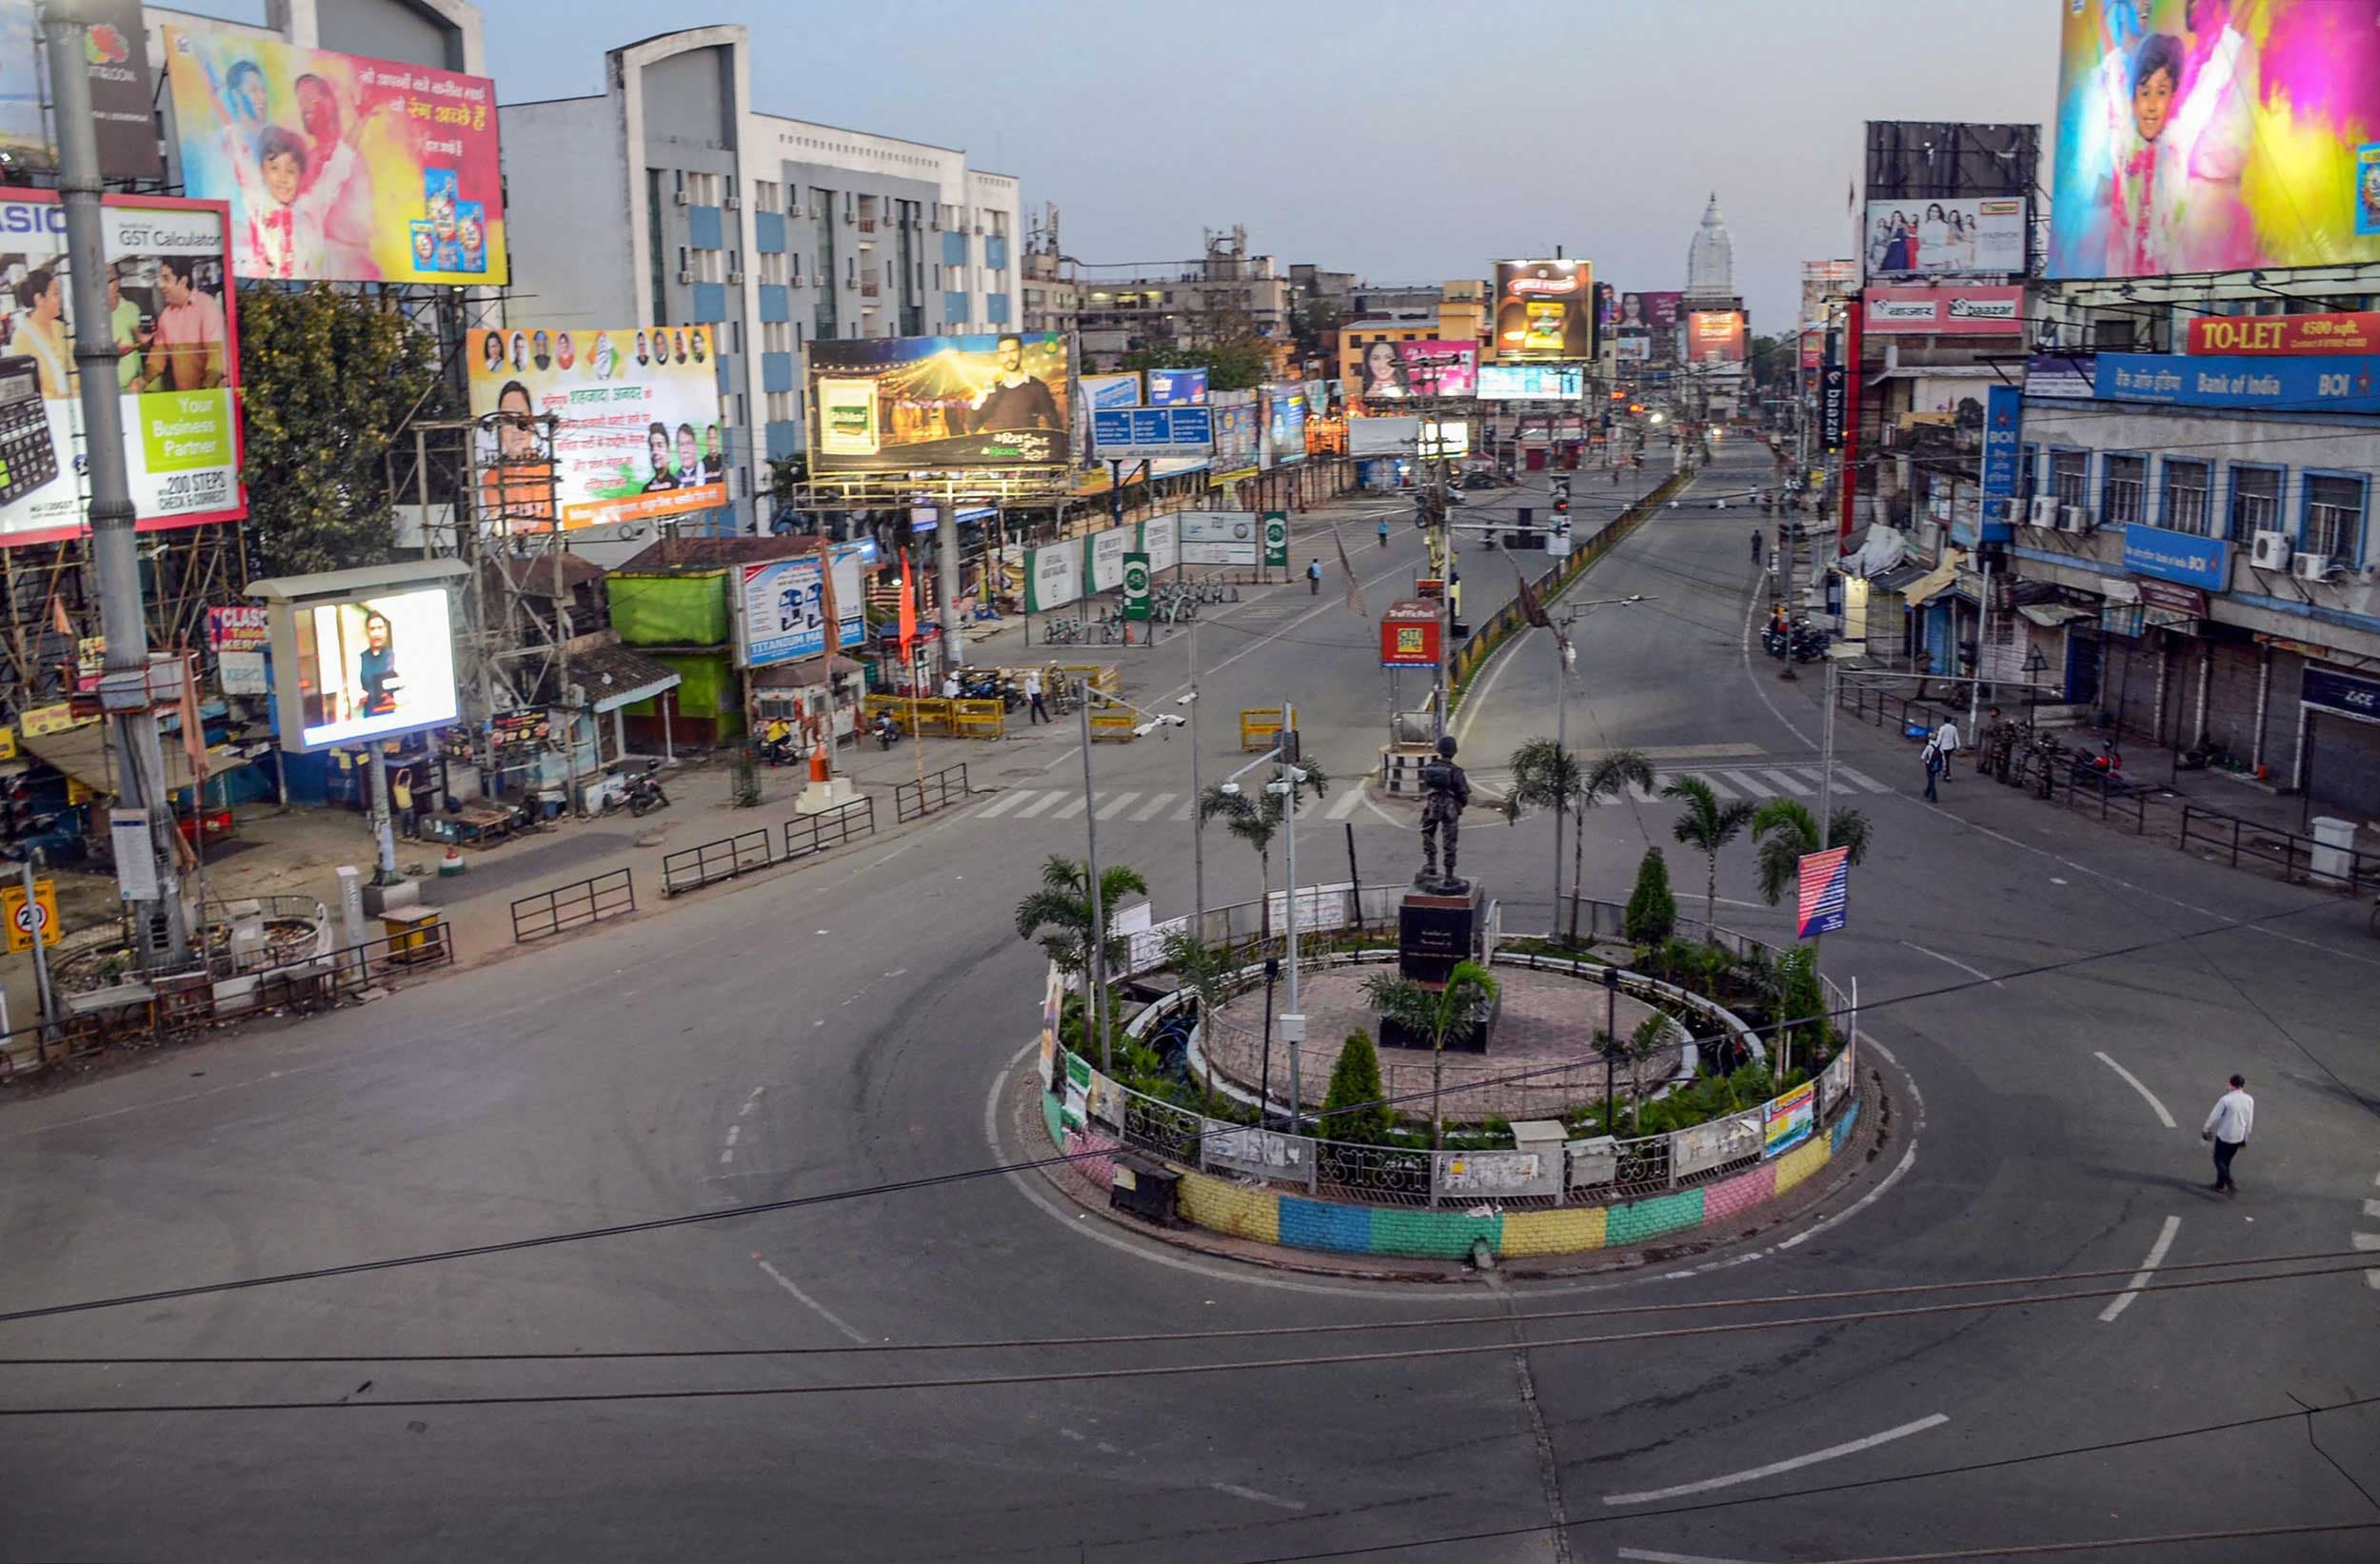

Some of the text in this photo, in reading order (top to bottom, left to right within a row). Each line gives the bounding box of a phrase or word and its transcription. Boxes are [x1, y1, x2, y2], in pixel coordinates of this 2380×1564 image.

[119, 230, 223, 250] GST Calculator
[2201, 322, 2288, 349] TO-LET
[2197, 372, 2281, 395] Bank of India
[2318, 373, 2350, 396] BOI
[178, 398, 214, 412] Your
[1826, 389, 1843, 444] baazar
[151, 420, 216, 437] Business
[1989, 431, 2015, 444] BOI
[165, 440, 217, 458] Partner
[168, 477, 189, 495] 200
[191, 471, 227, 491] STEPS
[2189, 555, 2207, 572] BOI
